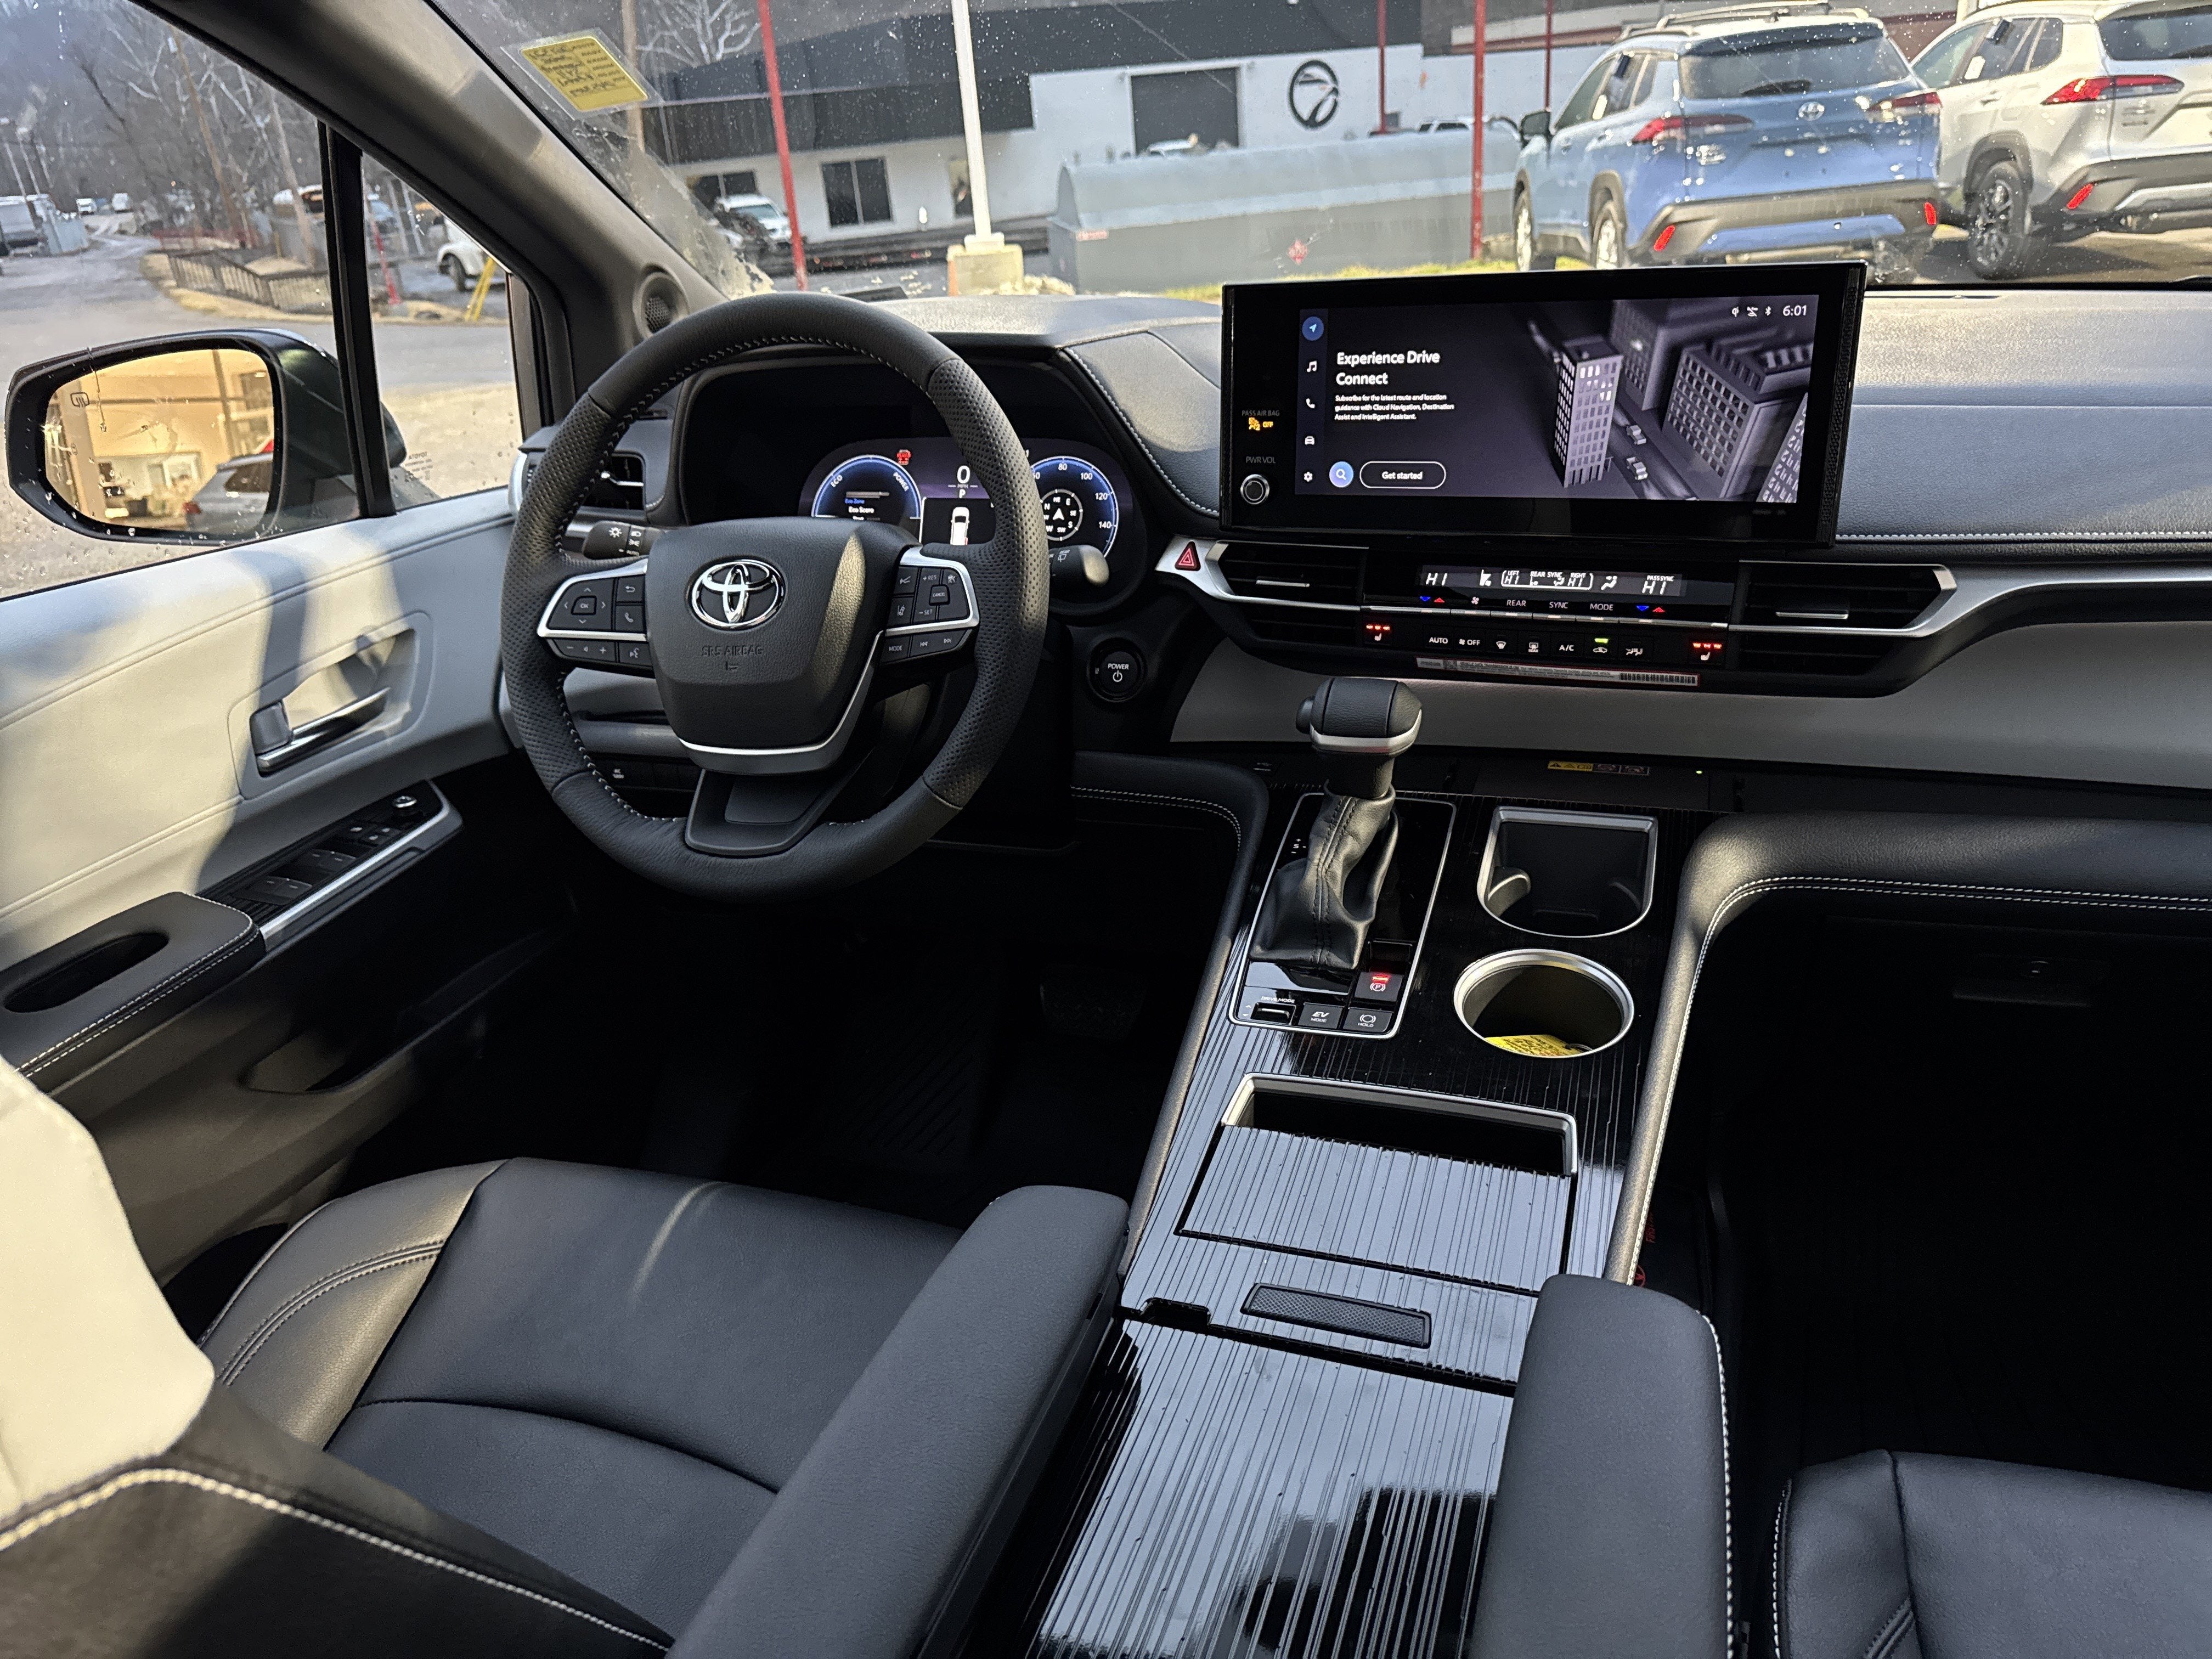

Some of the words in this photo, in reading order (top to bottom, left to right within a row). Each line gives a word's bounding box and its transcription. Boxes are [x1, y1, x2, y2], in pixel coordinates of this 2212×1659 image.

[1783, 305, 1807, 316] 6:01
[1337, 351, 1404, 367] Experience
[1407, 350, 1440, 363] Drive
[1336, 373, 1389, 385] Connect
[1362, 413, 1389, 421] Intelligent
[957, 465, 970, 484] 0
[1381, 471, 1396, 480] Get
[1396, 471, 1423, 480] started
[831, 475, 843, 488] ECO
[893, 471, 909, 492] POWER
[959, 489, 966, 499] P
[1425, 572, 1448, 586] HI
[1642, 580, 1667, 595] HI
[1590, 603, 1613, 611] MODE
